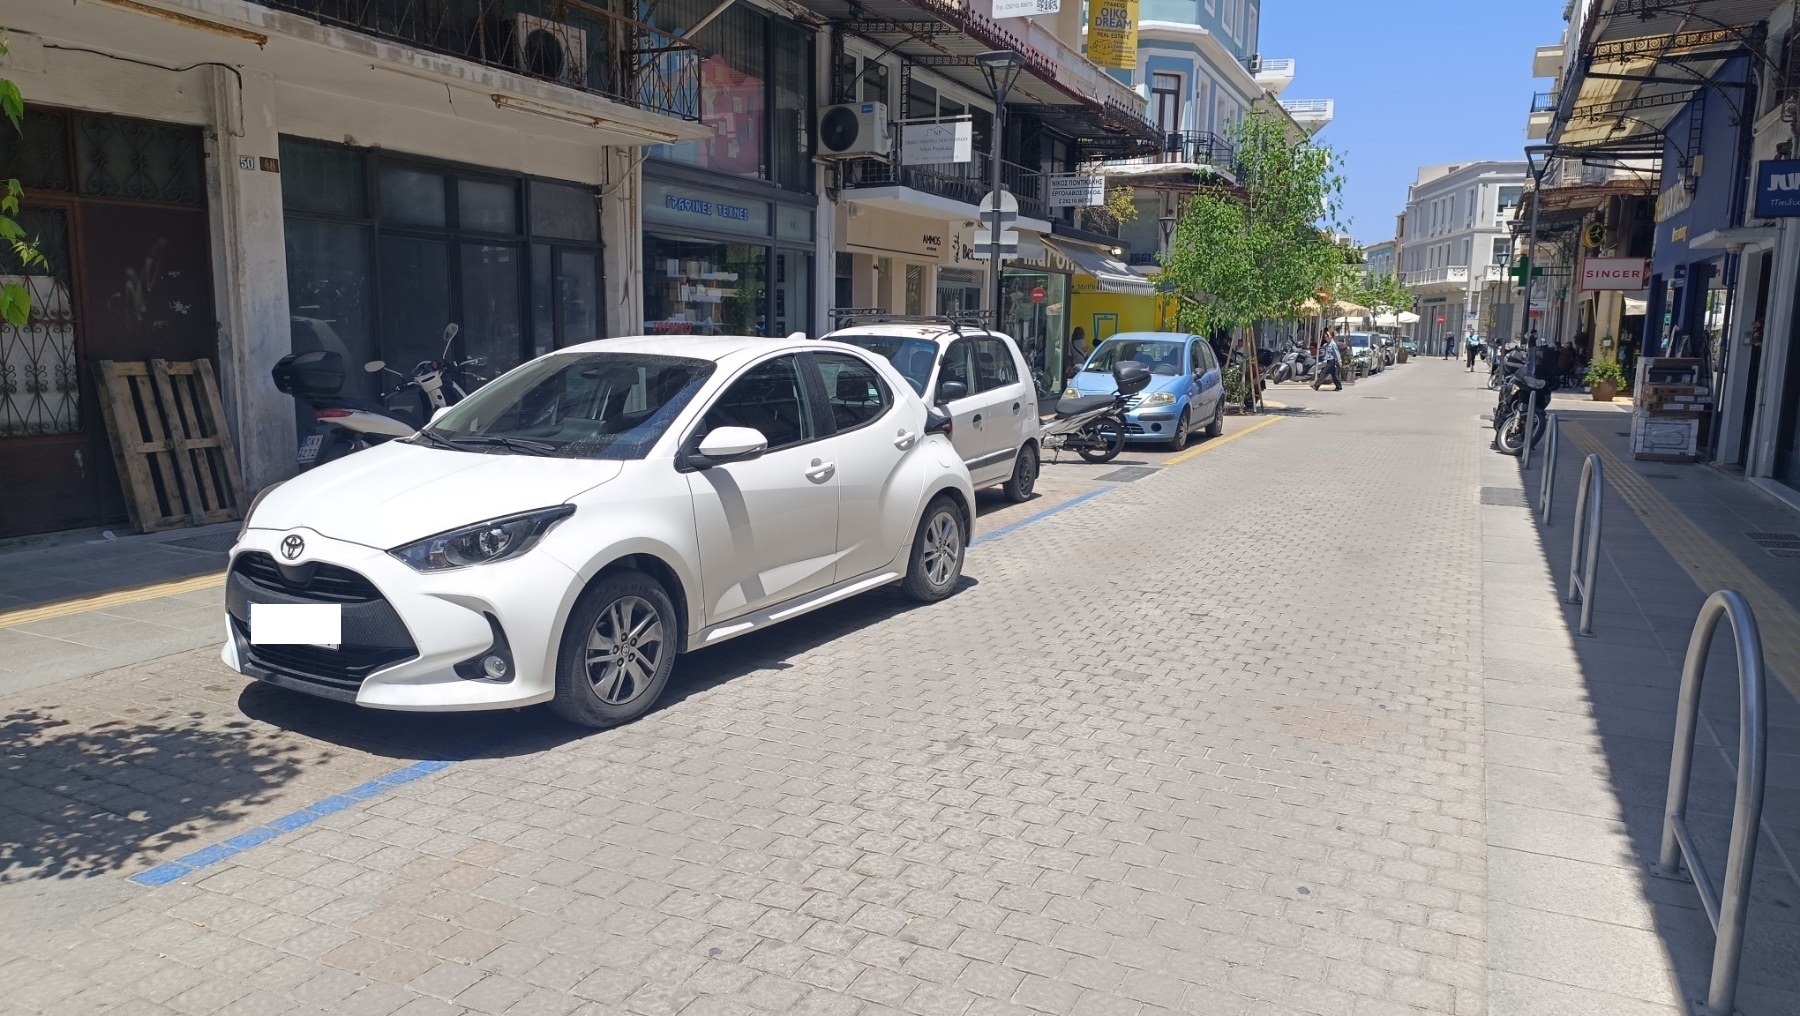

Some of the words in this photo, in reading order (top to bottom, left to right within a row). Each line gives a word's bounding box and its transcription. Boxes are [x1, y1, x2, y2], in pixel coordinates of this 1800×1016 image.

[1095, 16, 1132, 29] DREAM
[240, 157, 254, 170] 50
[666, 194, 713, 216] ΓΡΑΦΙΚΕΣ
[718, 204, 749, 222] ΤΕΧΝΕΣ
[1586, 270, 1640, 278] SINGER
